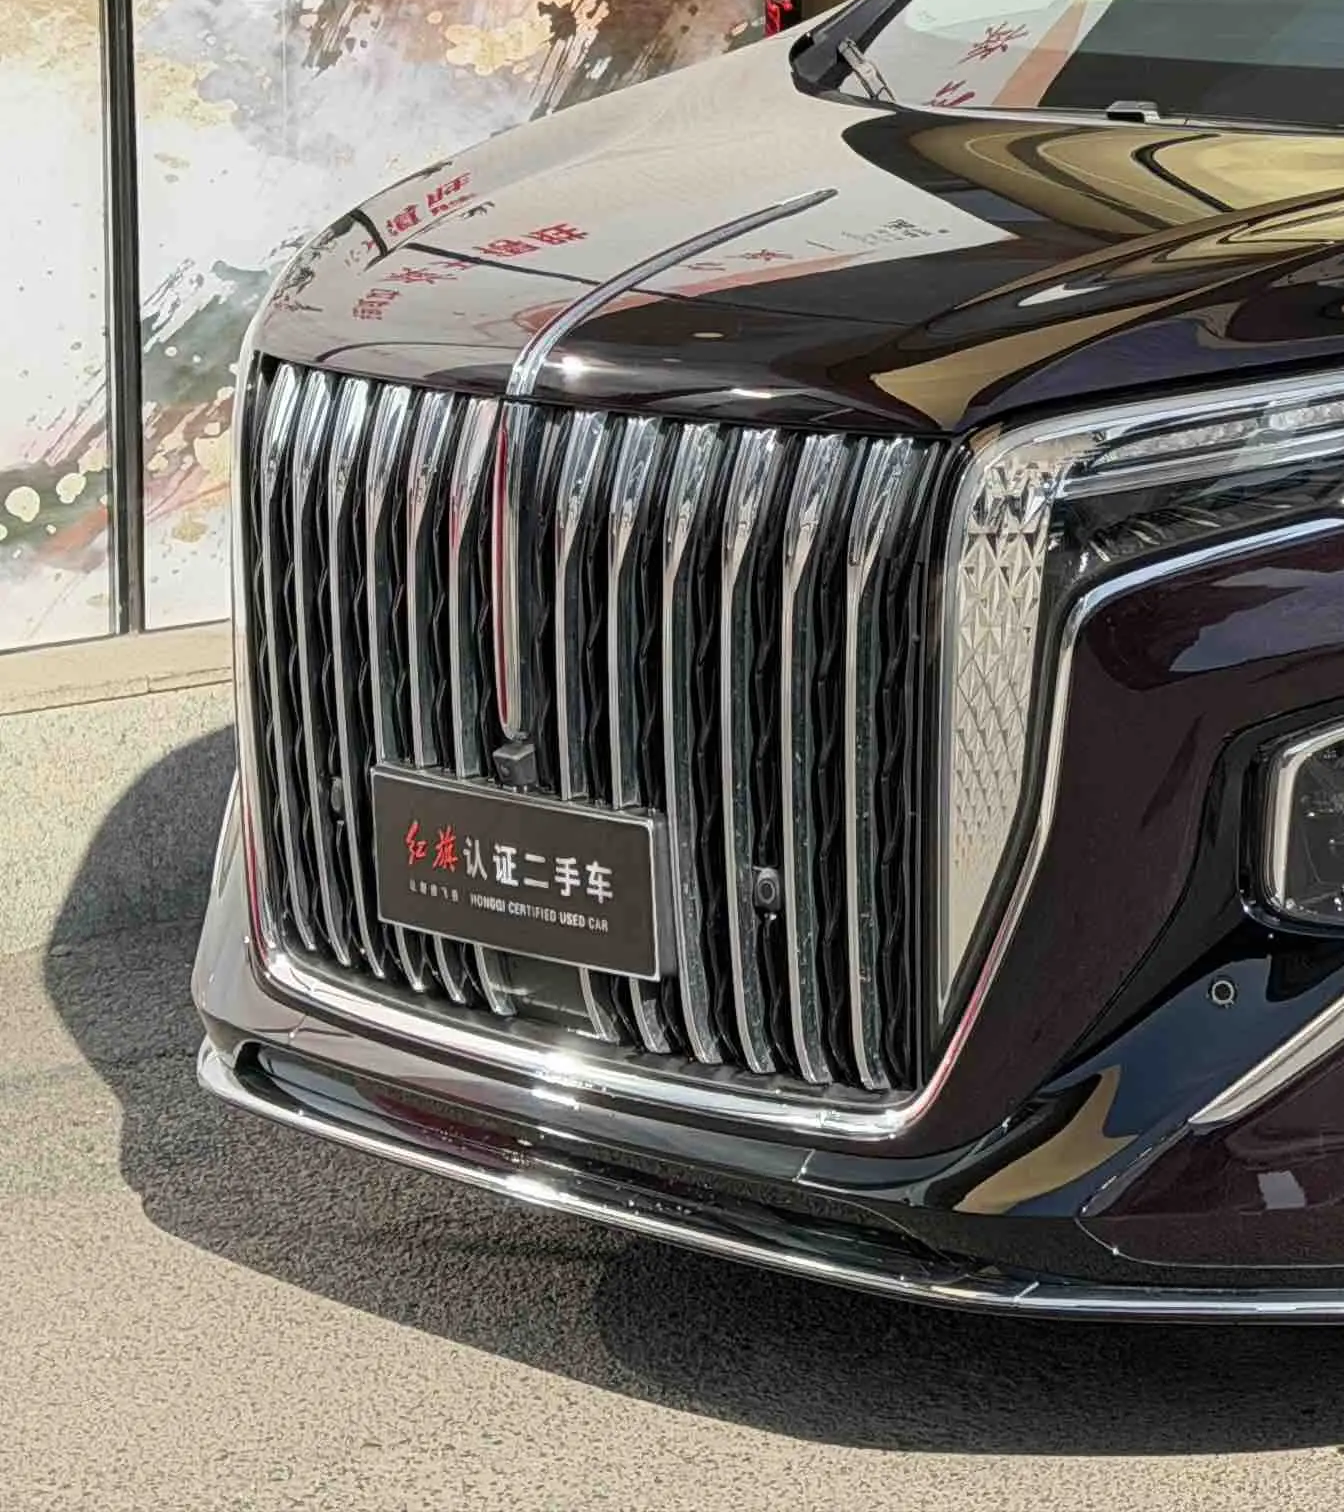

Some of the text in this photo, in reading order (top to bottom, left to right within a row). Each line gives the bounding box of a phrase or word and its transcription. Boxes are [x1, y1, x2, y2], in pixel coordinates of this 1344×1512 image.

[469, 892, 609, 932] HONGQI CERTIFIED USED CAR
